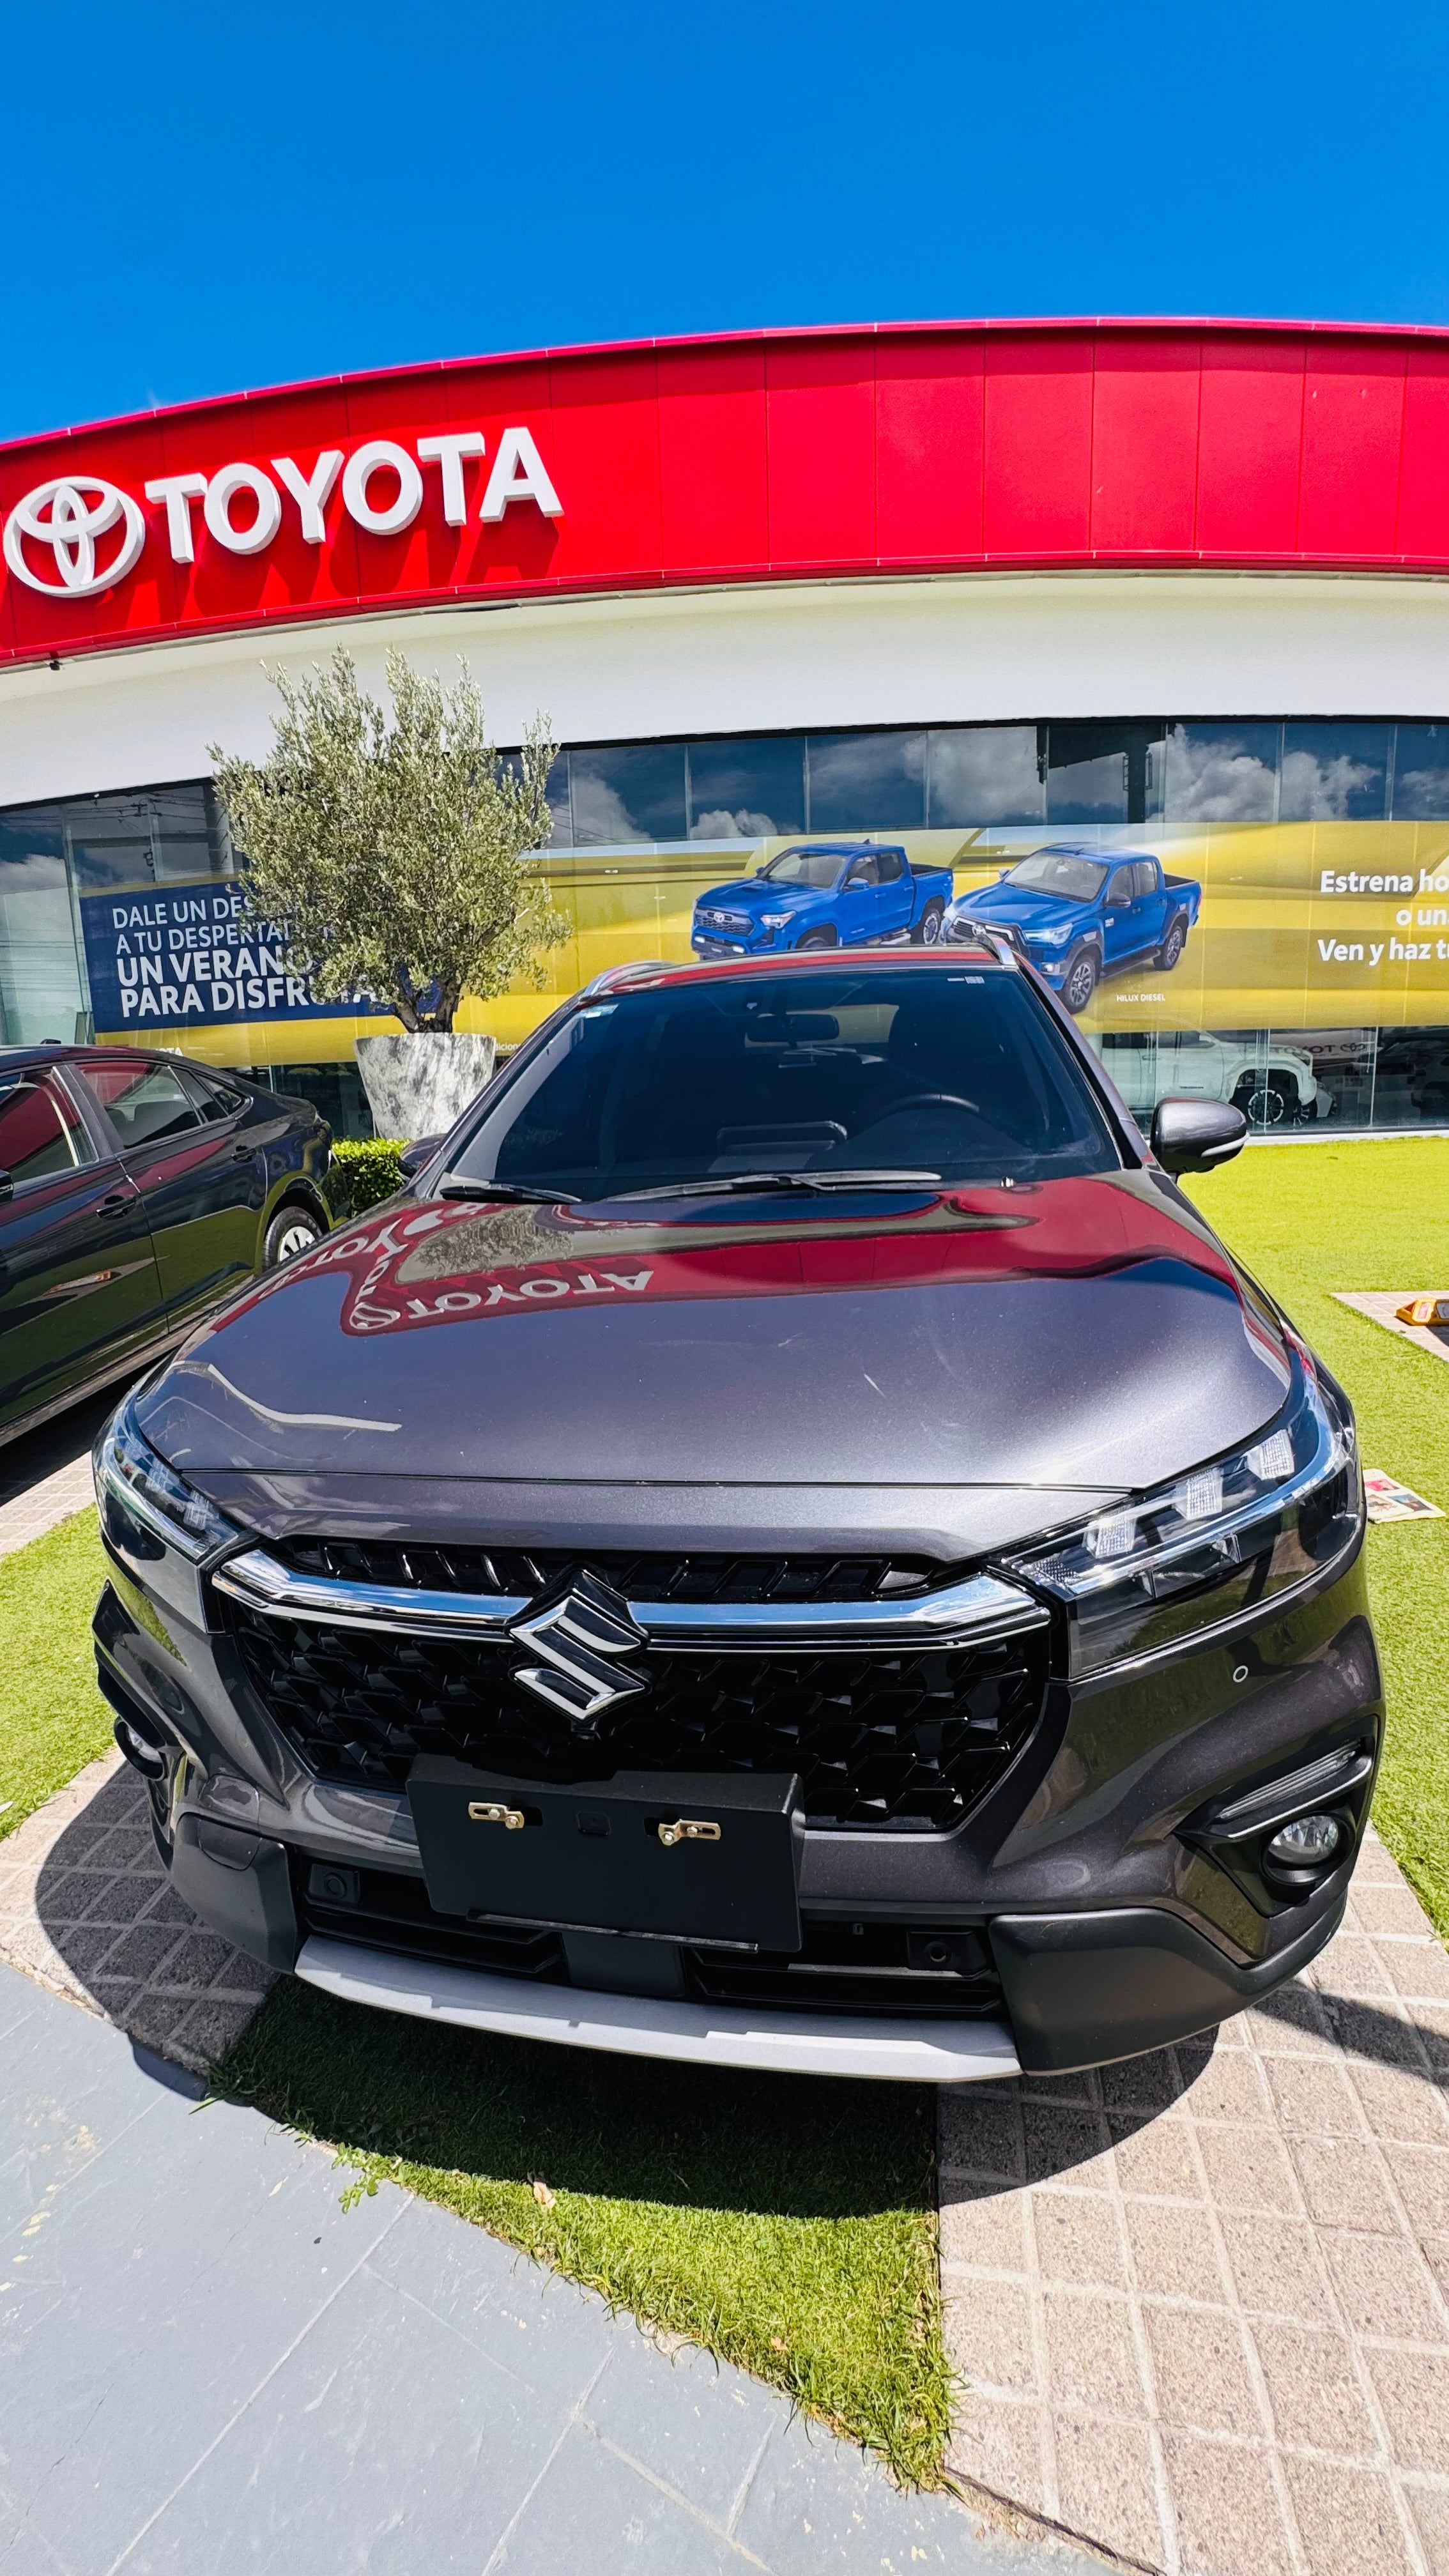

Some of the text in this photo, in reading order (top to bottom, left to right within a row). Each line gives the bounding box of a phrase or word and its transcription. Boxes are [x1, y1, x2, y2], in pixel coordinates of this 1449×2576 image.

[144, 427, 564, 564] TOYOTA
[1321, 870, 1413, 893] Estrena
[112, 903, 167, 929] DALE
[172, 900, 206, 923] UN
[1396, 909, 1449, 926] o un
[116, 934, 131, 955] A
[134, 930, 162, 953] TU
[1317, 937, 1449, 966] Ven y haz t
[117, 955, 164, 986] UN
[121, 984, 204, 1018] PARA
[1116, 993, 1165, 1002] HILUX DIESEL
